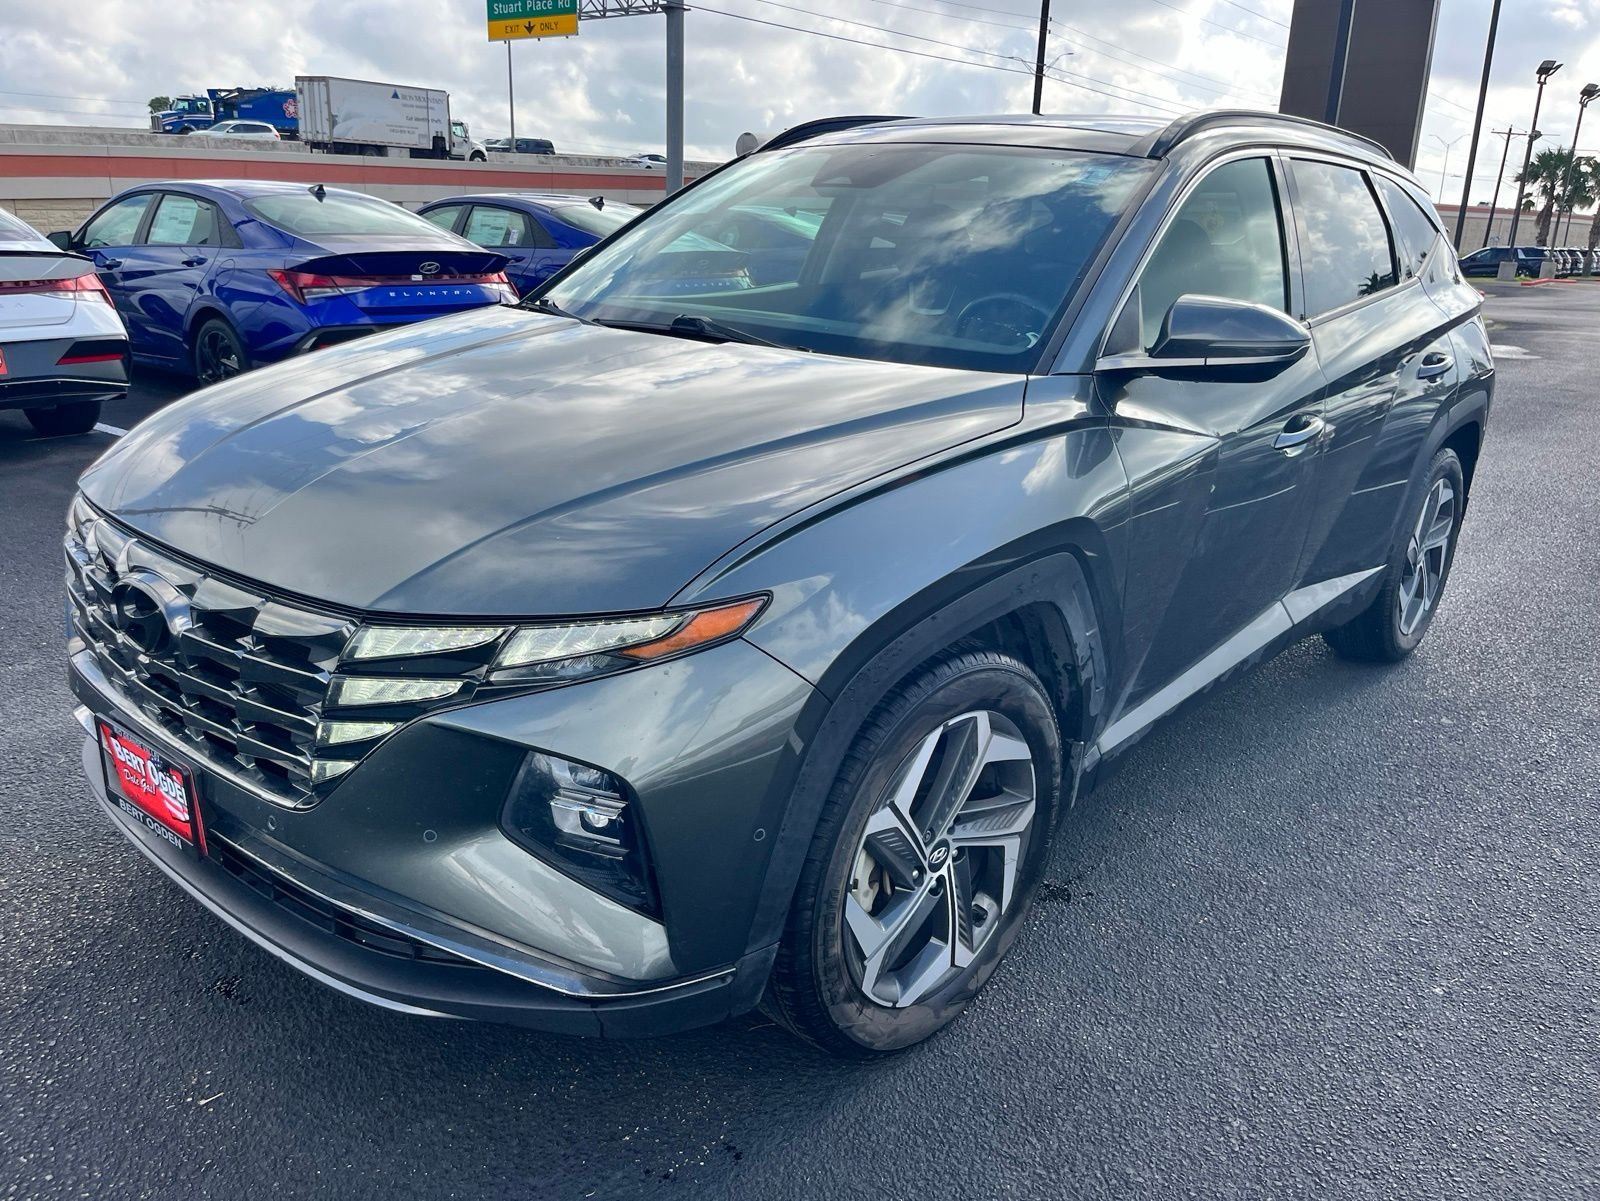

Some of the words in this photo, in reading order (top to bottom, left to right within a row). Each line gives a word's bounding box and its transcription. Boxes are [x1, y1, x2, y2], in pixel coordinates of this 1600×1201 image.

[493, 1, 522, 14] Stuart
[526, 0, 553, 11] Place
[505, 25, 519, 33] EXIT
[540, 22, 559, 31] ONLY
[110, 736, 146, 776] BERT
[119, 798, 145, 822] BERT
[146, 817, 182, 850] OGDEN
